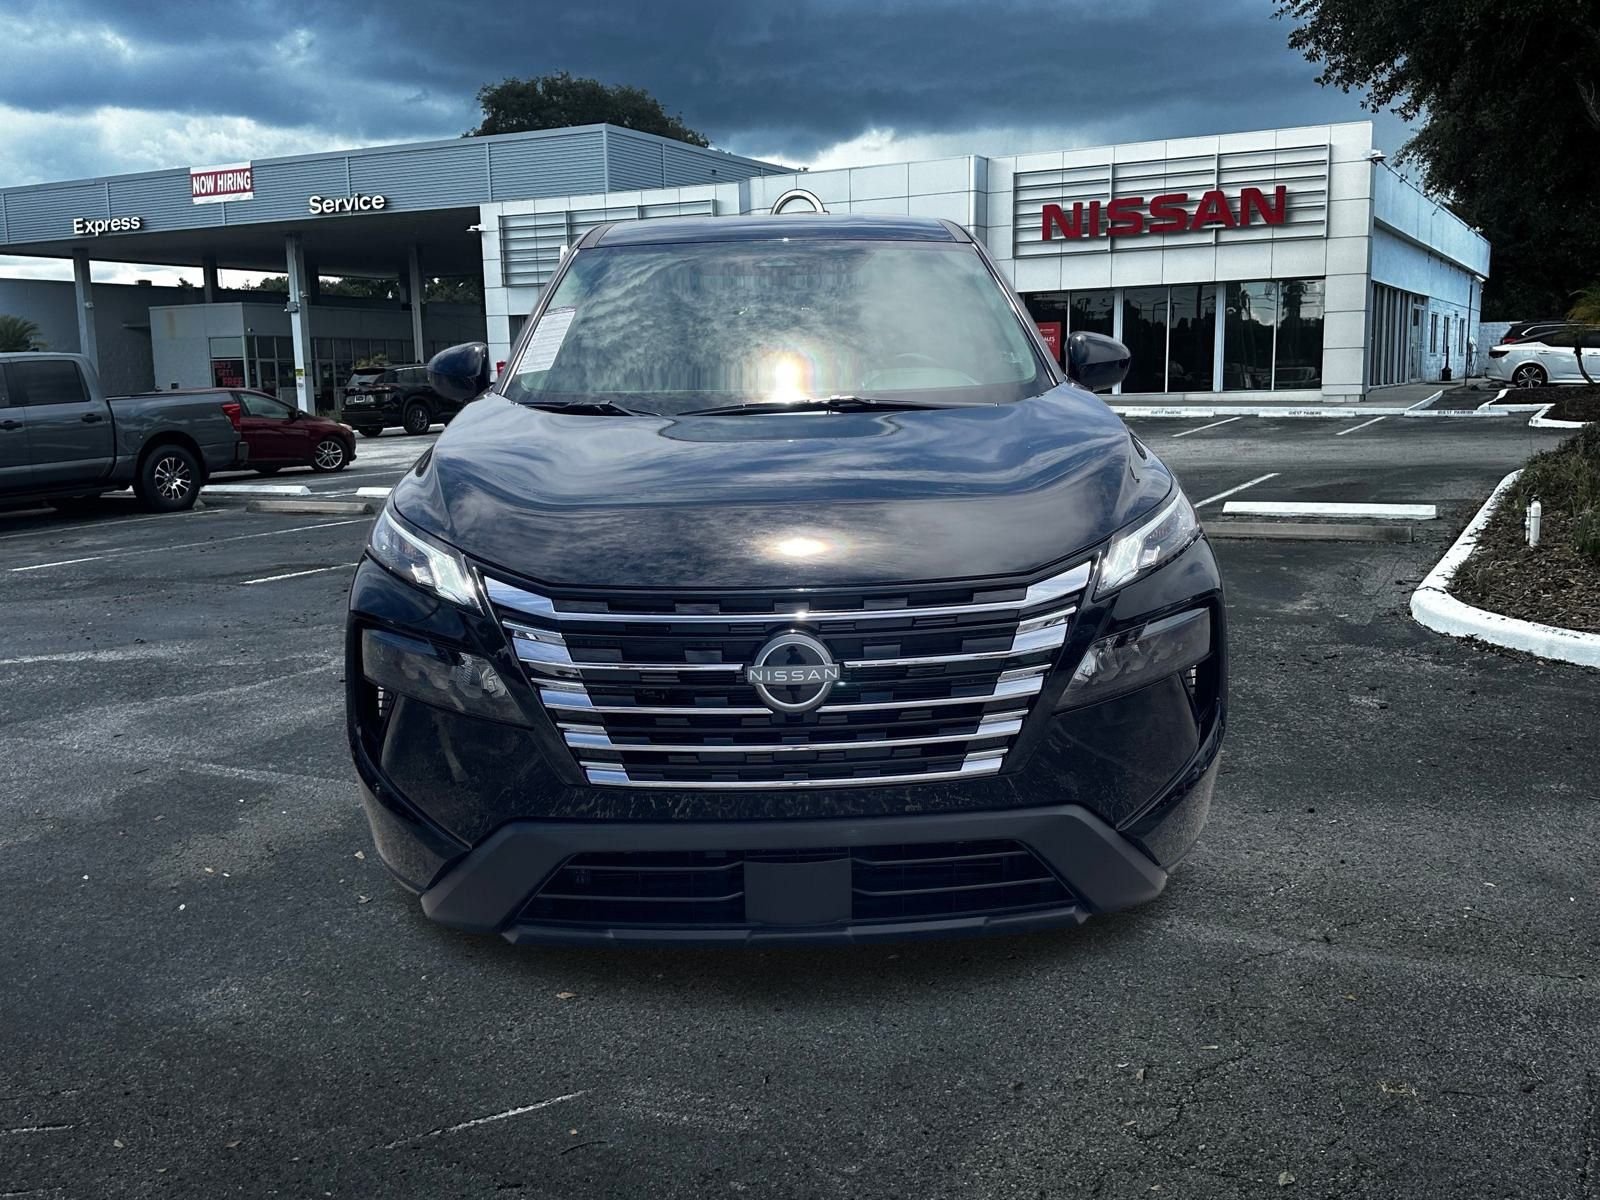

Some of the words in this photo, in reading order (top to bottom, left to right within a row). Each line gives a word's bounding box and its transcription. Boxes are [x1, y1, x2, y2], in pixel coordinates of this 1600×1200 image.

[193, 174, 215, 195] NOW
[217, 170, 251, 192] HIRING
[309, 193, 385, 214] Service
[1041, 185, 1287, 241] NISSAN
[73, 216, 141, 237] Express
[749, 667, 838, 682] NISSAN
